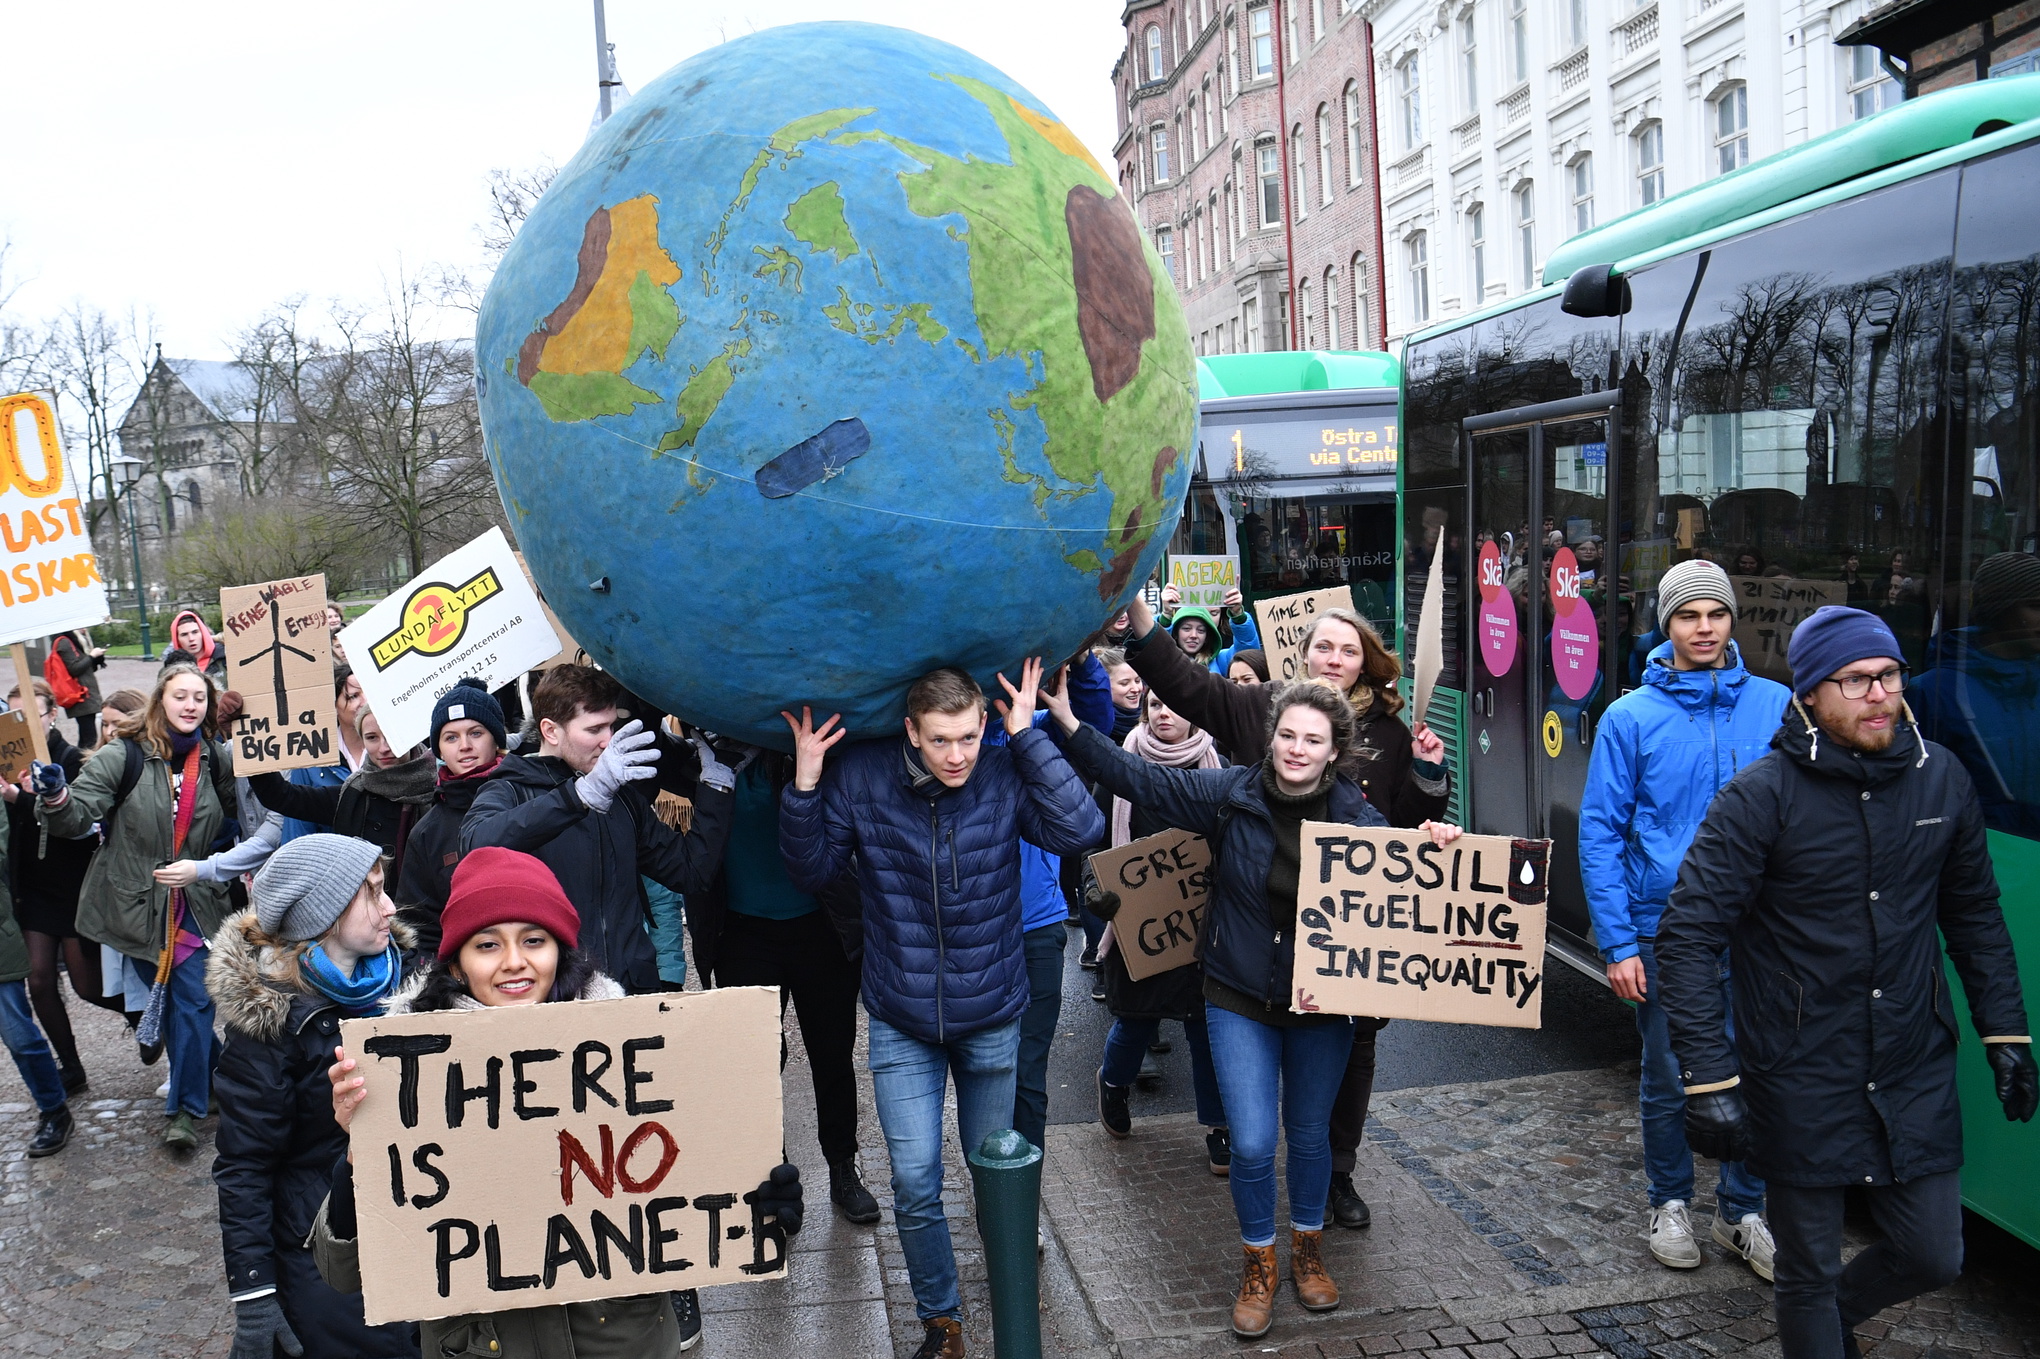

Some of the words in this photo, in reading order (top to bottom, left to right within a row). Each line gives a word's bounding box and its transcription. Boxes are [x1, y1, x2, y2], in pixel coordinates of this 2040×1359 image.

[1231, 429, 1243, 472] 1
[1321, 428, 1378, 446] Östra
[1310, 448, 1341, 466] via
[1172, 561, 1235, 588] AGERA
[284, 609, 328, 638] Energy
[378, 577, 491, 661] LUNDAFLYTT
[413, 595, 457, 646] 2
[1267, 604, 1300, 623] TIME
[1304, 597, 1316, 614] IS
[1485, 613, 1510, 626] Välkommen
[1489, 627, 1495, 636] in
[1495, 628, 1505, 638] även
[1493, 639, 1501, 650] här
[1559, 629, 1590, 643] Välkommen
[391, 671, 439, 707] Engelholms
[438, 623, 509, 674] transportcentral
[509, 615, 523, 628] AB
[1564, 644, 1571, 653] in
[1571, 645, 1584, 656] även
[1569, 658, 1579, 669] här
[433, 686, 452, 700] 046
[471, 662, 484, 675] 12
[486, 653, 498, 667] 15
[299, 710, 315, 725] a
[241, 735, 280, 761] BIG
[287, 728, 330, 759] FAN
[1315, 836, 1504, 894] FOSSIL
[1340, 889, 1520, 942] FUELING
[1315, 944, 1542, 1009] INEQUALITY
[364, 1033, 676, 1129] THERE
[387, 1142, 451, 1210] IS
[556, 1120, 680, 1206] NO
[426, 1191, 788, 1297] PLANET-B
